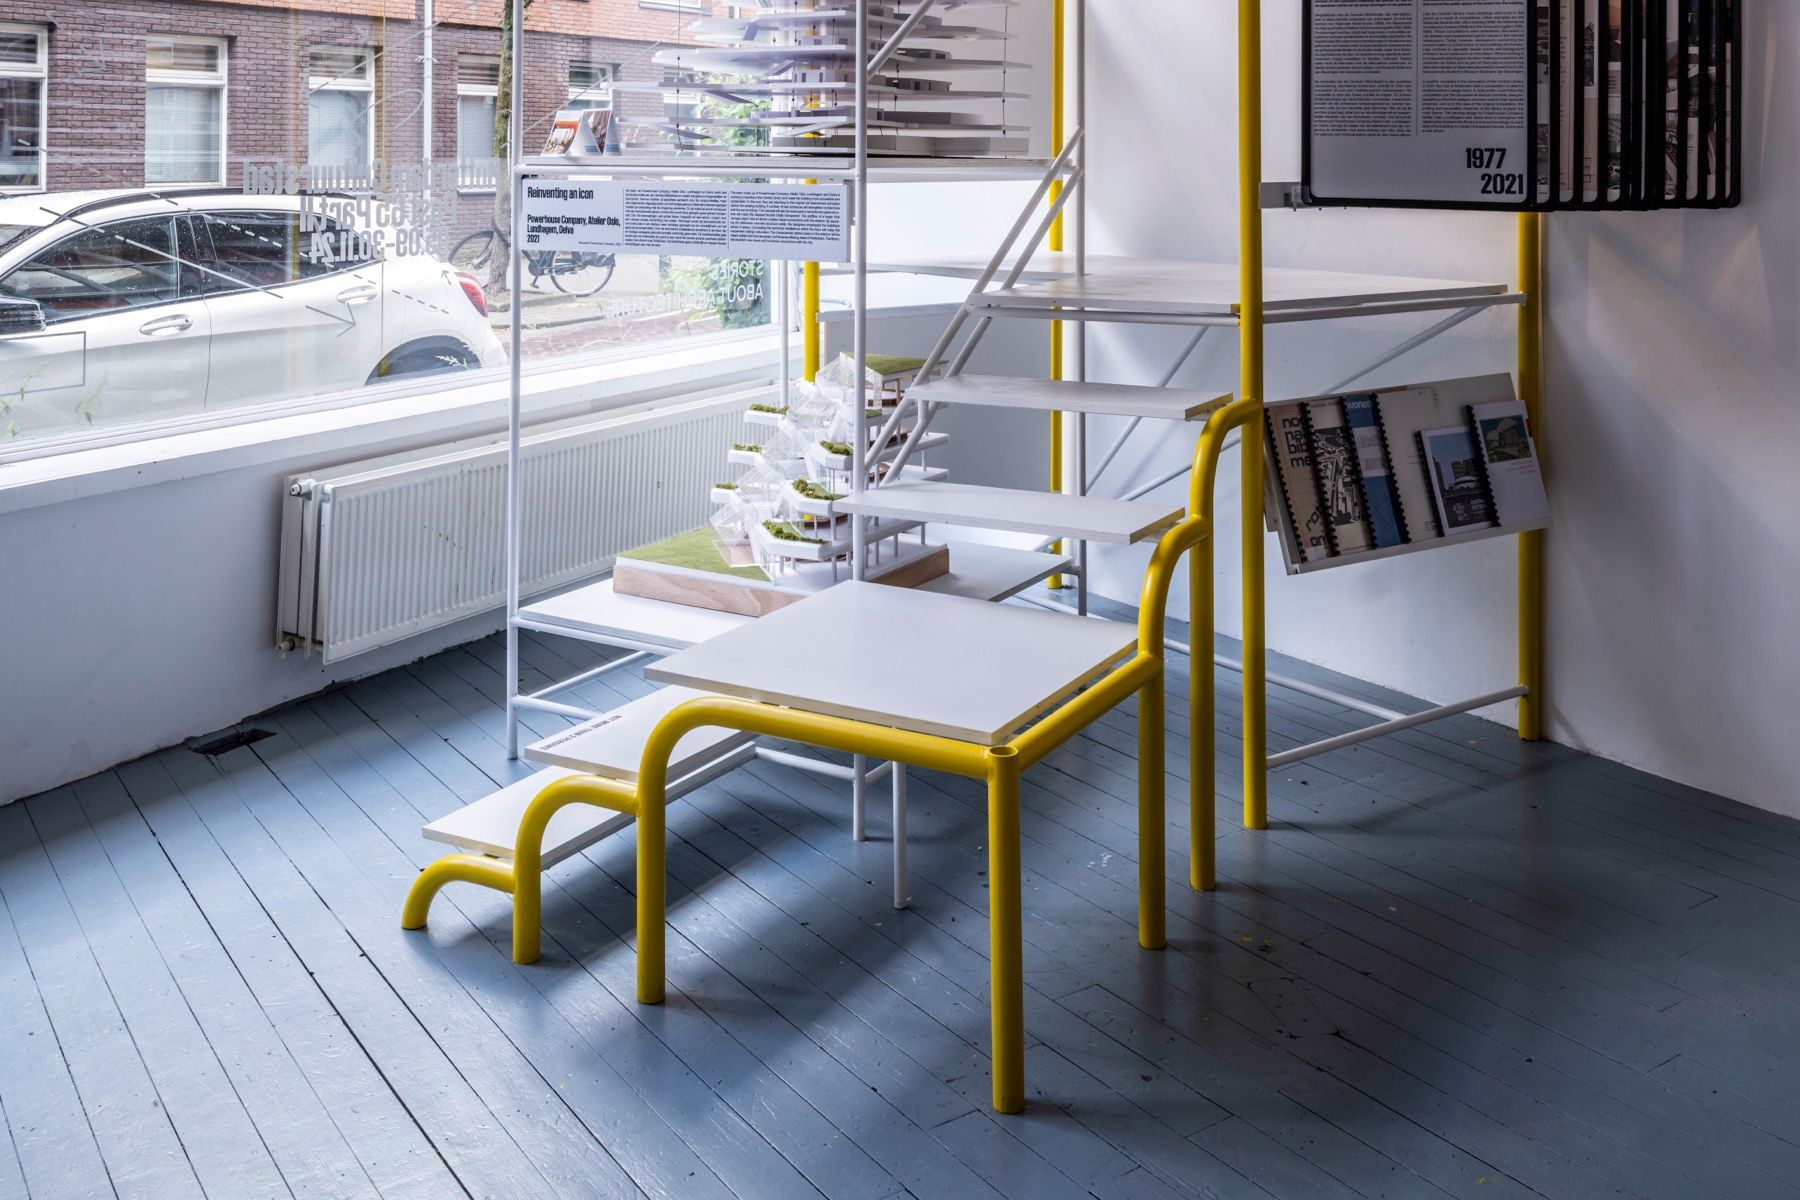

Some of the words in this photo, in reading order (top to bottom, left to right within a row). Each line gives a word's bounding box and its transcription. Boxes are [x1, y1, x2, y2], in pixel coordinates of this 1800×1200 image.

[1465, 147, 1507, 169] 1977
[1480, 173, 1524, 195] 2021
[527, 186, 568, 201] Reinventing
[568, 189, 578, 200] an
[578, 187, 594, 200] icon
[527, 214, 561, 224] Powerhouse
[561, 215, 588, 226] Company,
[588, 216, 606, 226] Atelier
[606, 216, 621, 228] Oslo,
[559, 225, 574, 235] Delva
[527, 234, 540, 243] 2021
